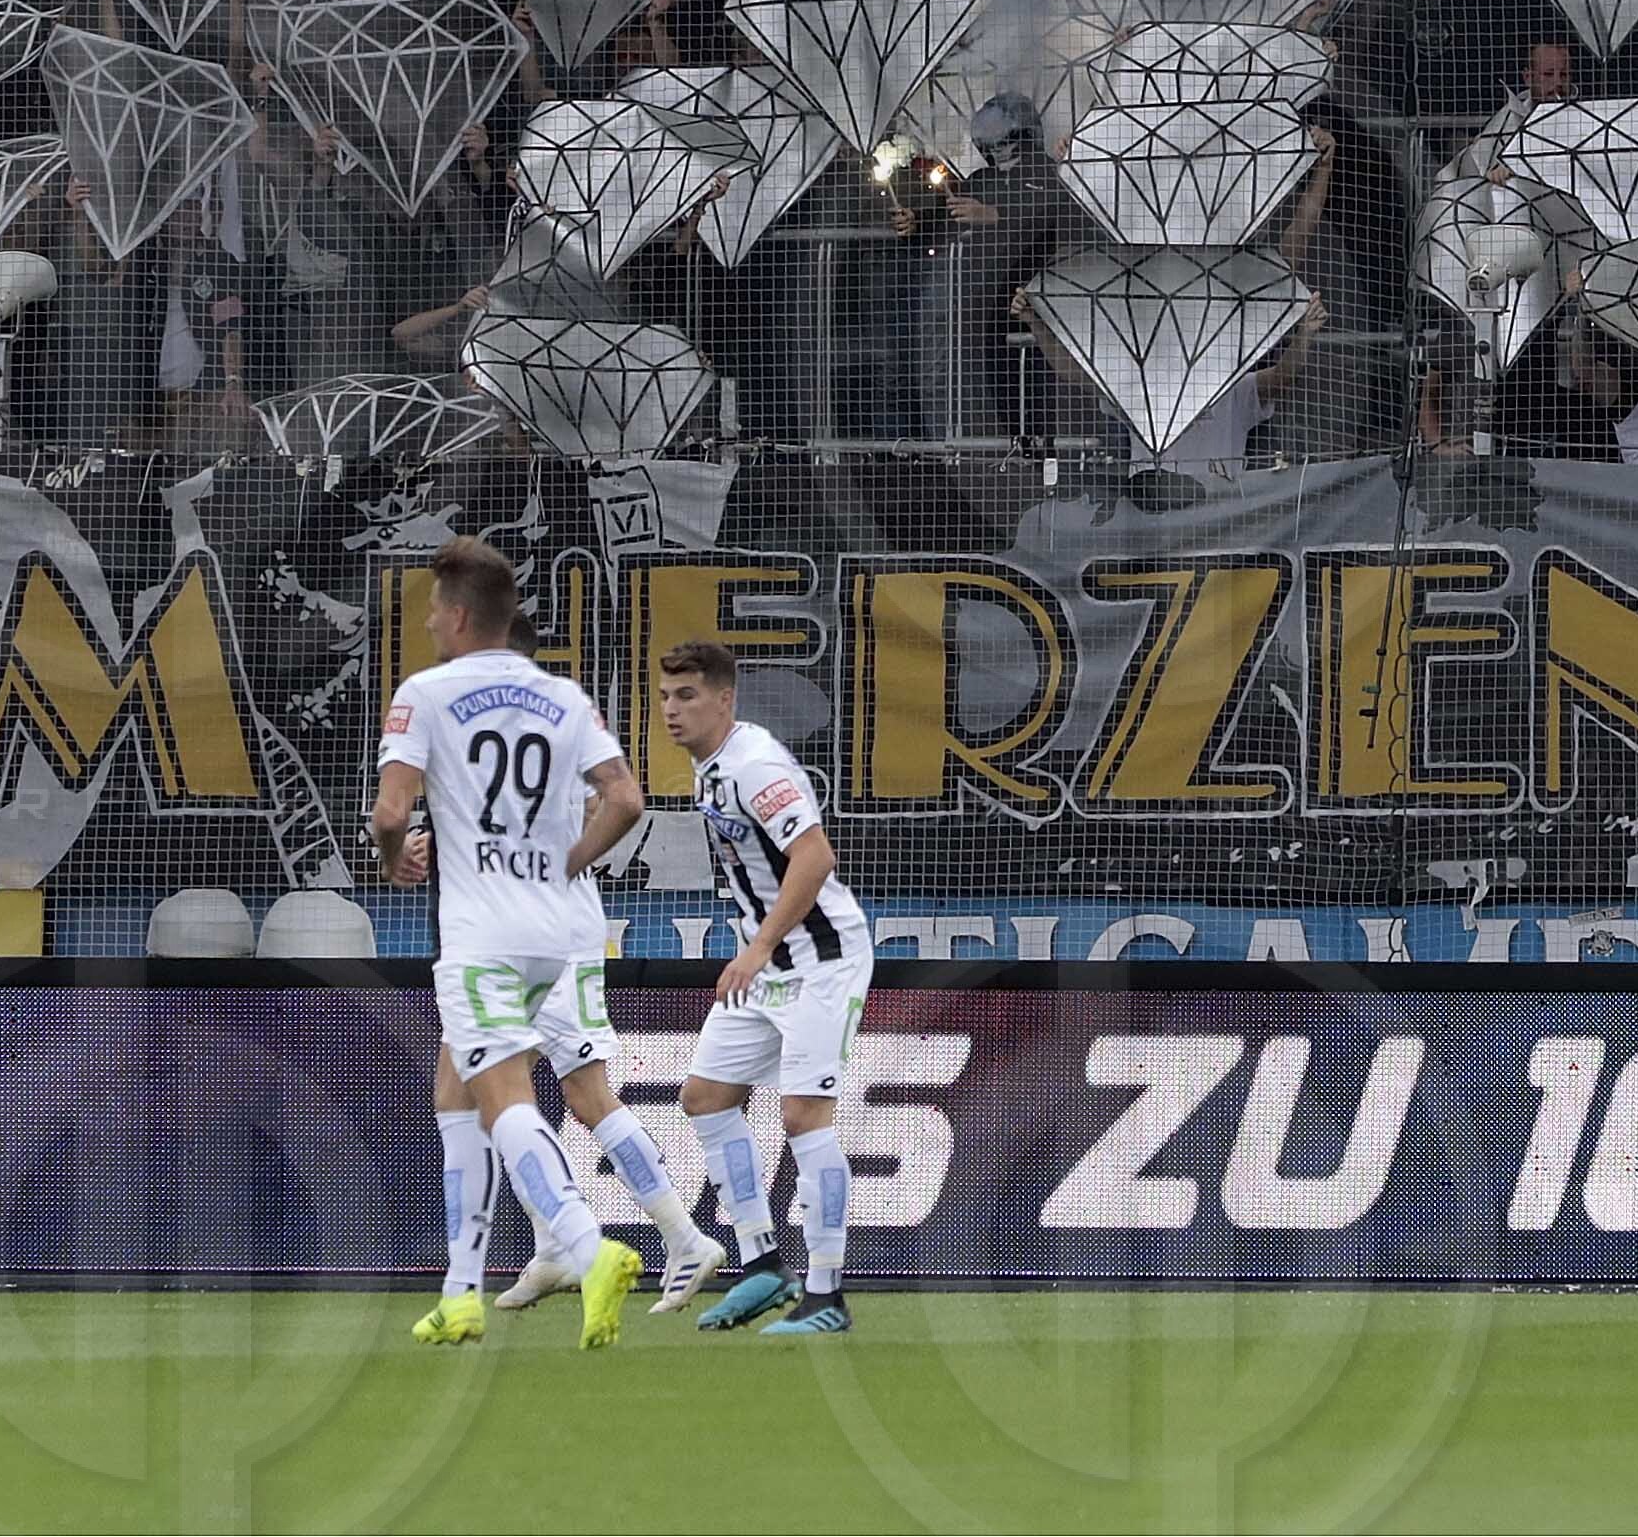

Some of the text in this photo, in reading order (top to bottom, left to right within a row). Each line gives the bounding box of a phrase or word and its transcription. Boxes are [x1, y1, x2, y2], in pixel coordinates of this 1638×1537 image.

[451, 687, 561, 724] PUNTIGAMER
[468, 729, 552, 838] 29
[1041, 1035, 1426, 1231] ZU
